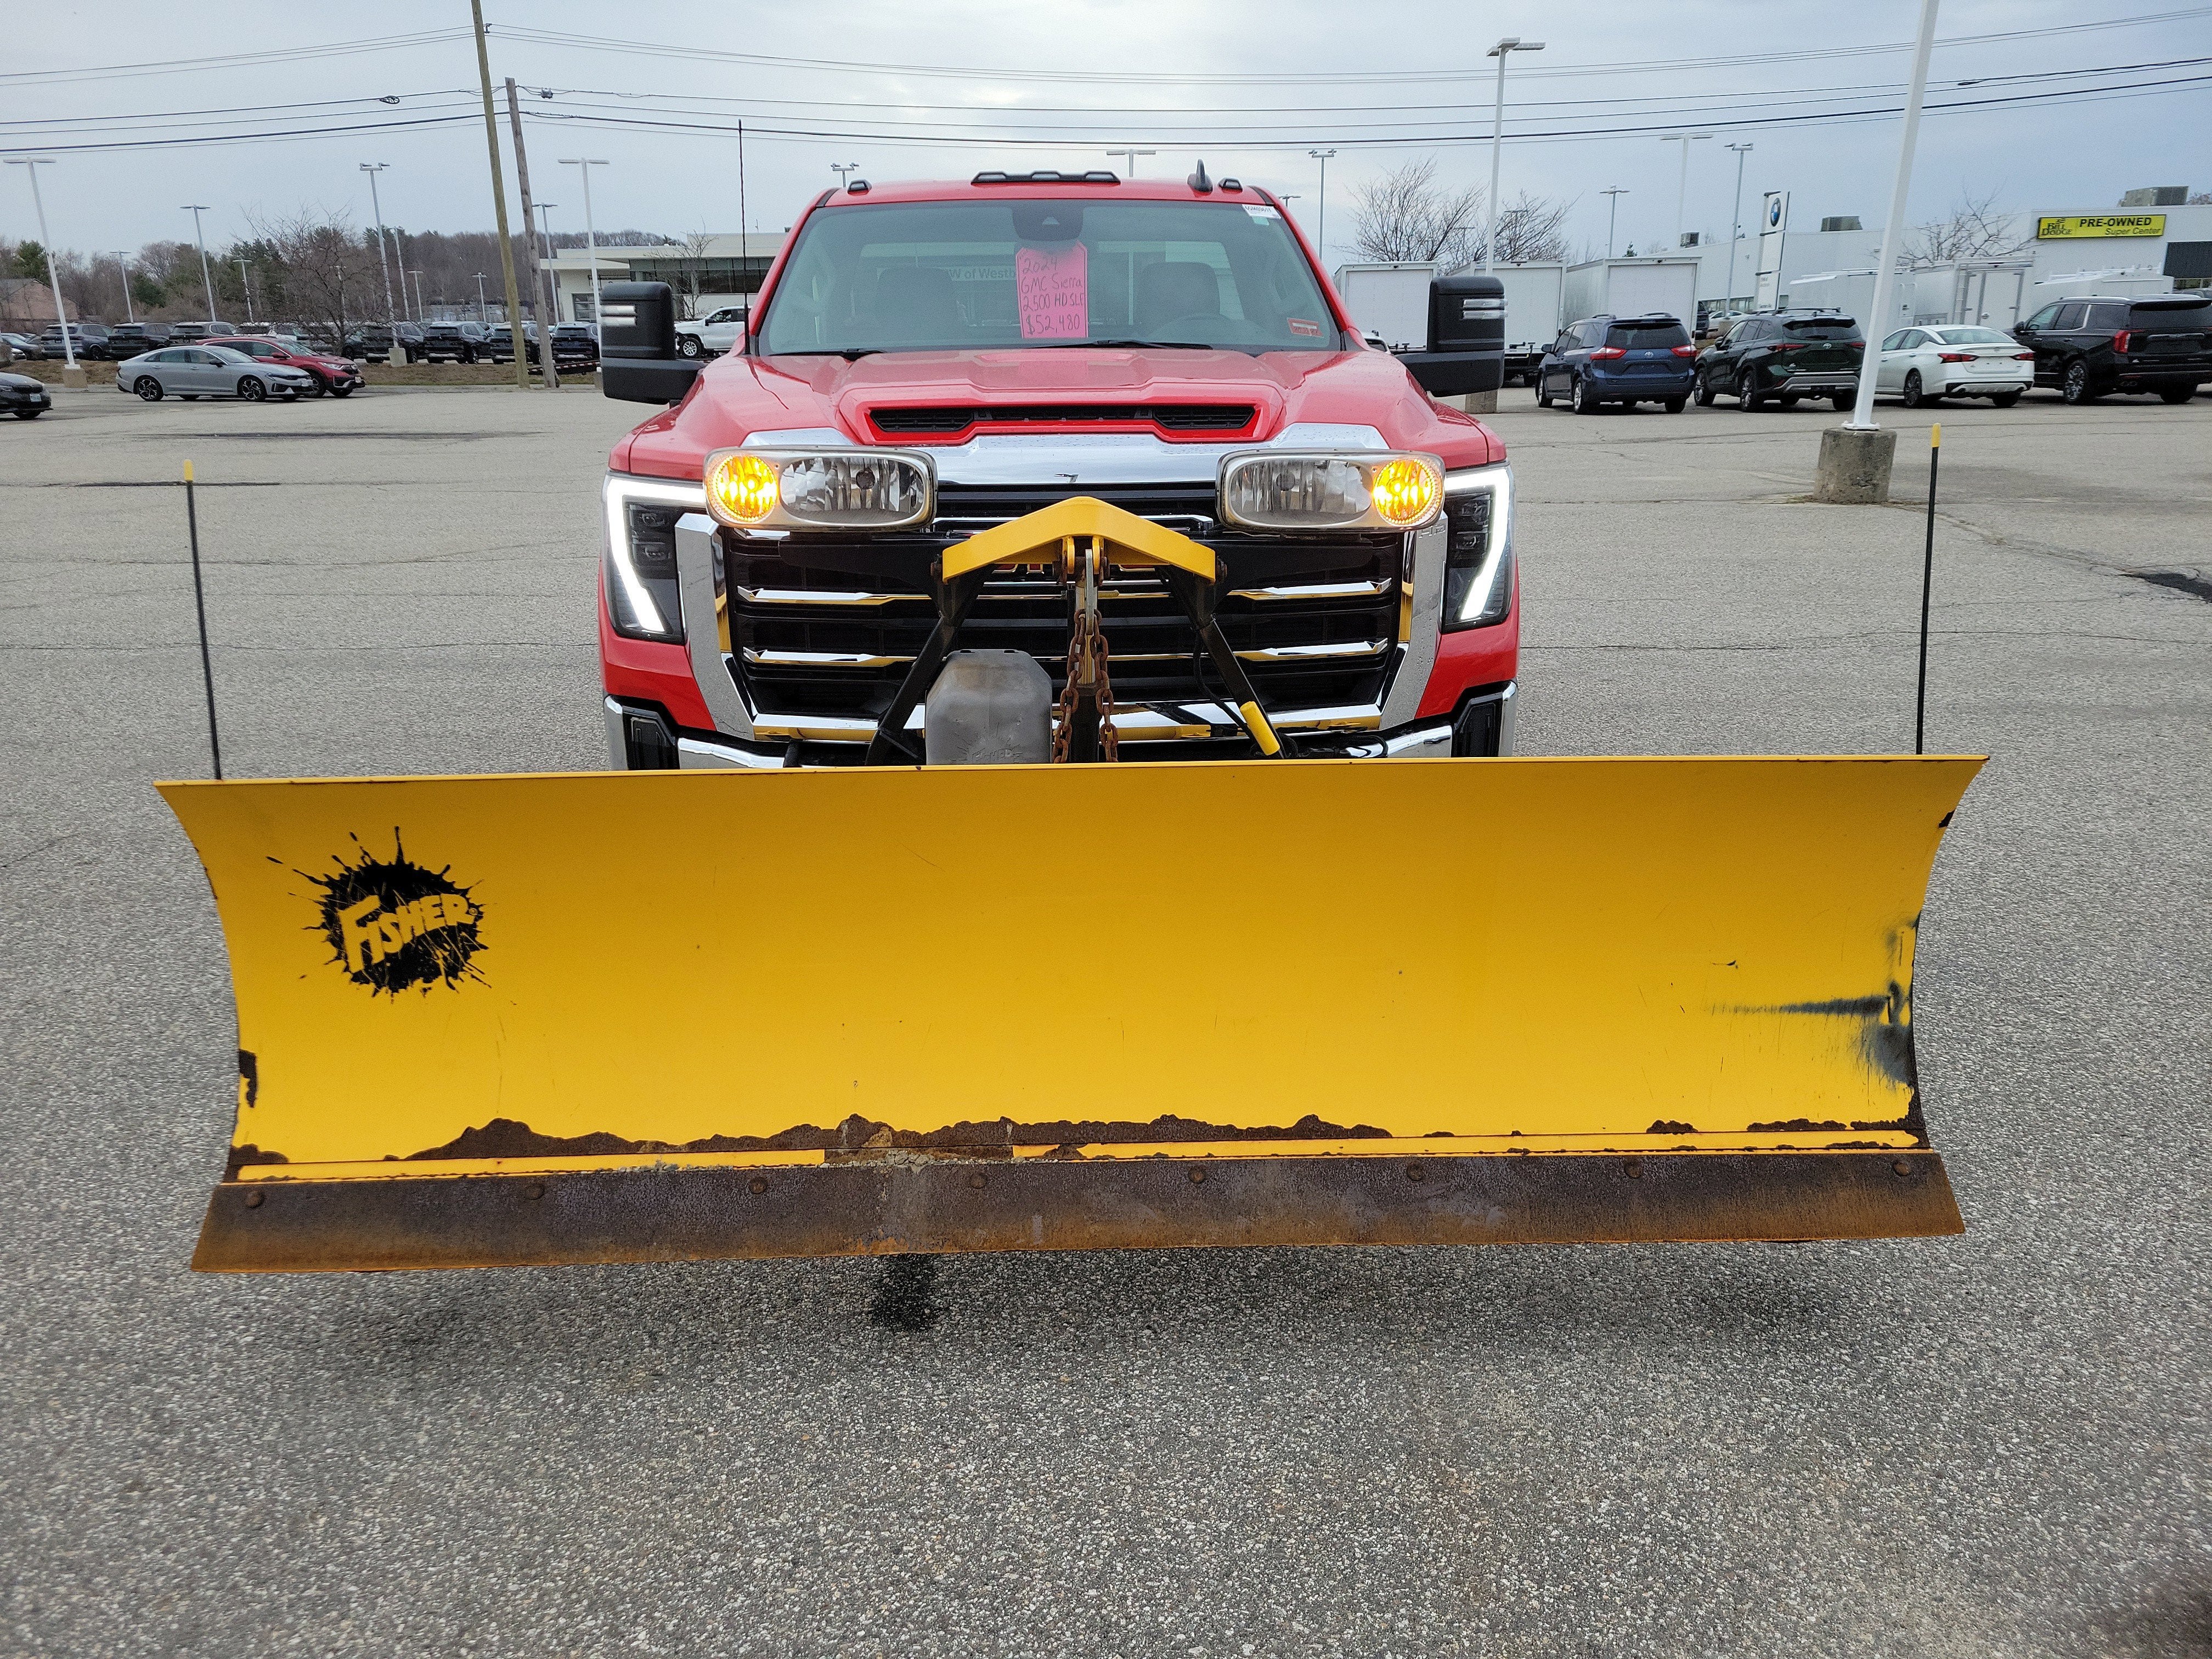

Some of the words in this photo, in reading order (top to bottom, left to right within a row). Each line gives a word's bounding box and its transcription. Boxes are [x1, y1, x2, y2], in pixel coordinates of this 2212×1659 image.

[2079, 217, 2152, 227] PRE-OWNED
[2104, 228, 2129, 236] Super
[1023, 256, 1057, 274] 2024
[1021, 275, 1047, 294] GMC
[1052, 273, 1082, 290] Sierra
[1023, 293, 1051, 312] 2500
[1054, 293, 1068, 307] HD
[1026, 313, 1080, 335] $52,480
[336, 894, 476, 973] FISHER
